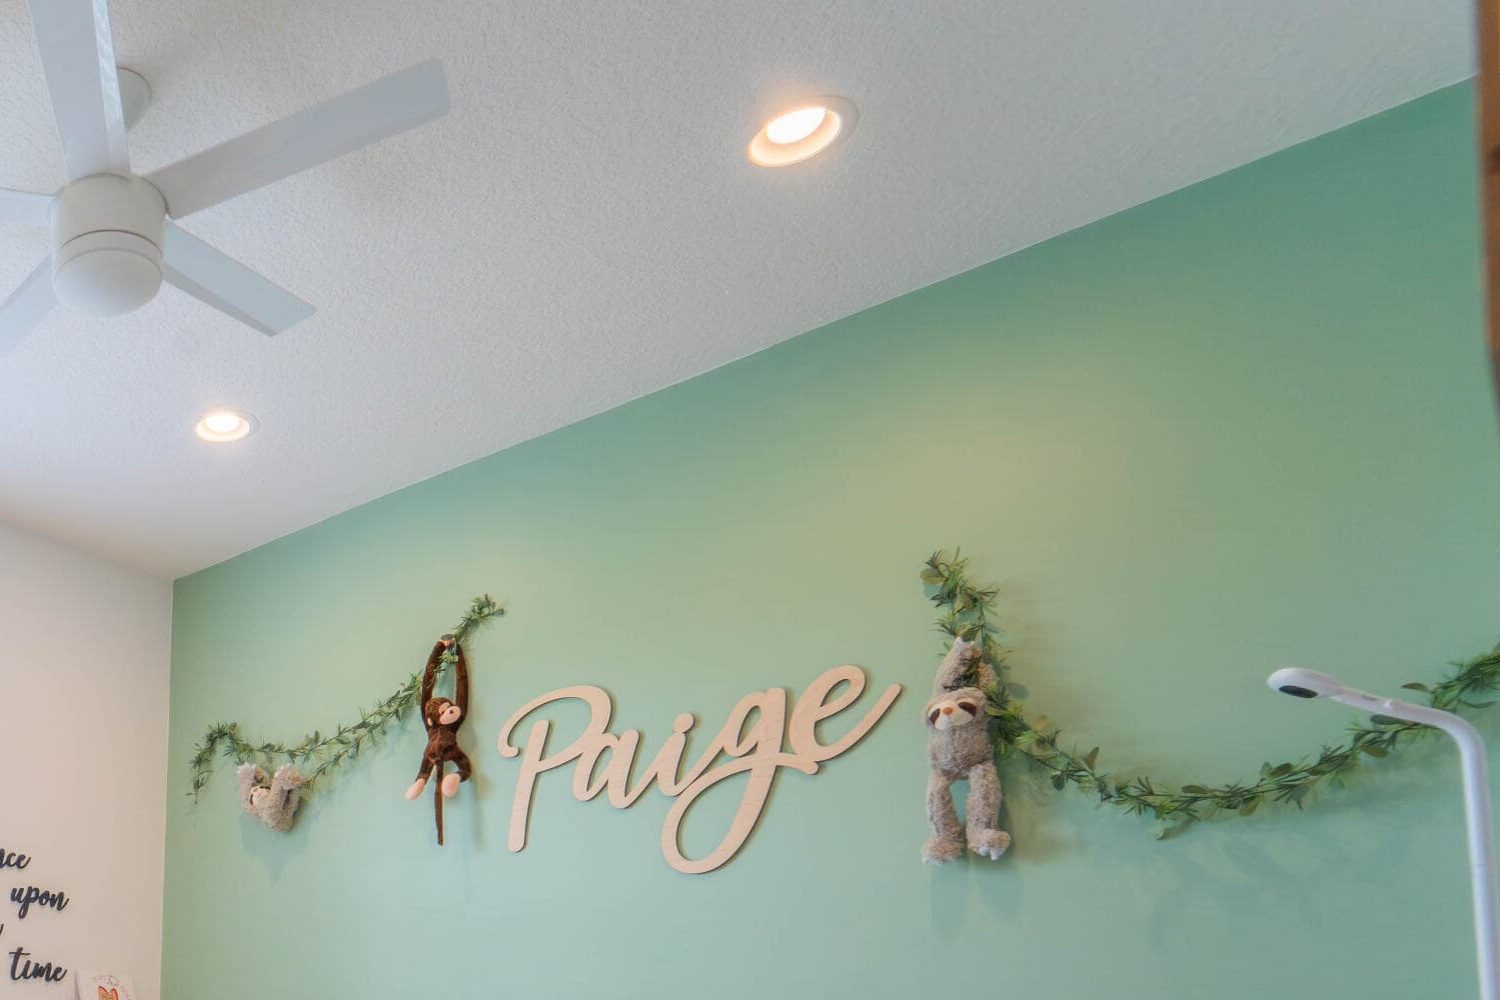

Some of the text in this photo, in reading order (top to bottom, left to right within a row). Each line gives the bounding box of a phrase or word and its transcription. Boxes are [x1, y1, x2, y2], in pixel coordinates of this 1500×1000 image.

[497, 665, 902, 875] Paige
[10, 886, 70, 919] upon
[8, 946, 68, 982] time
